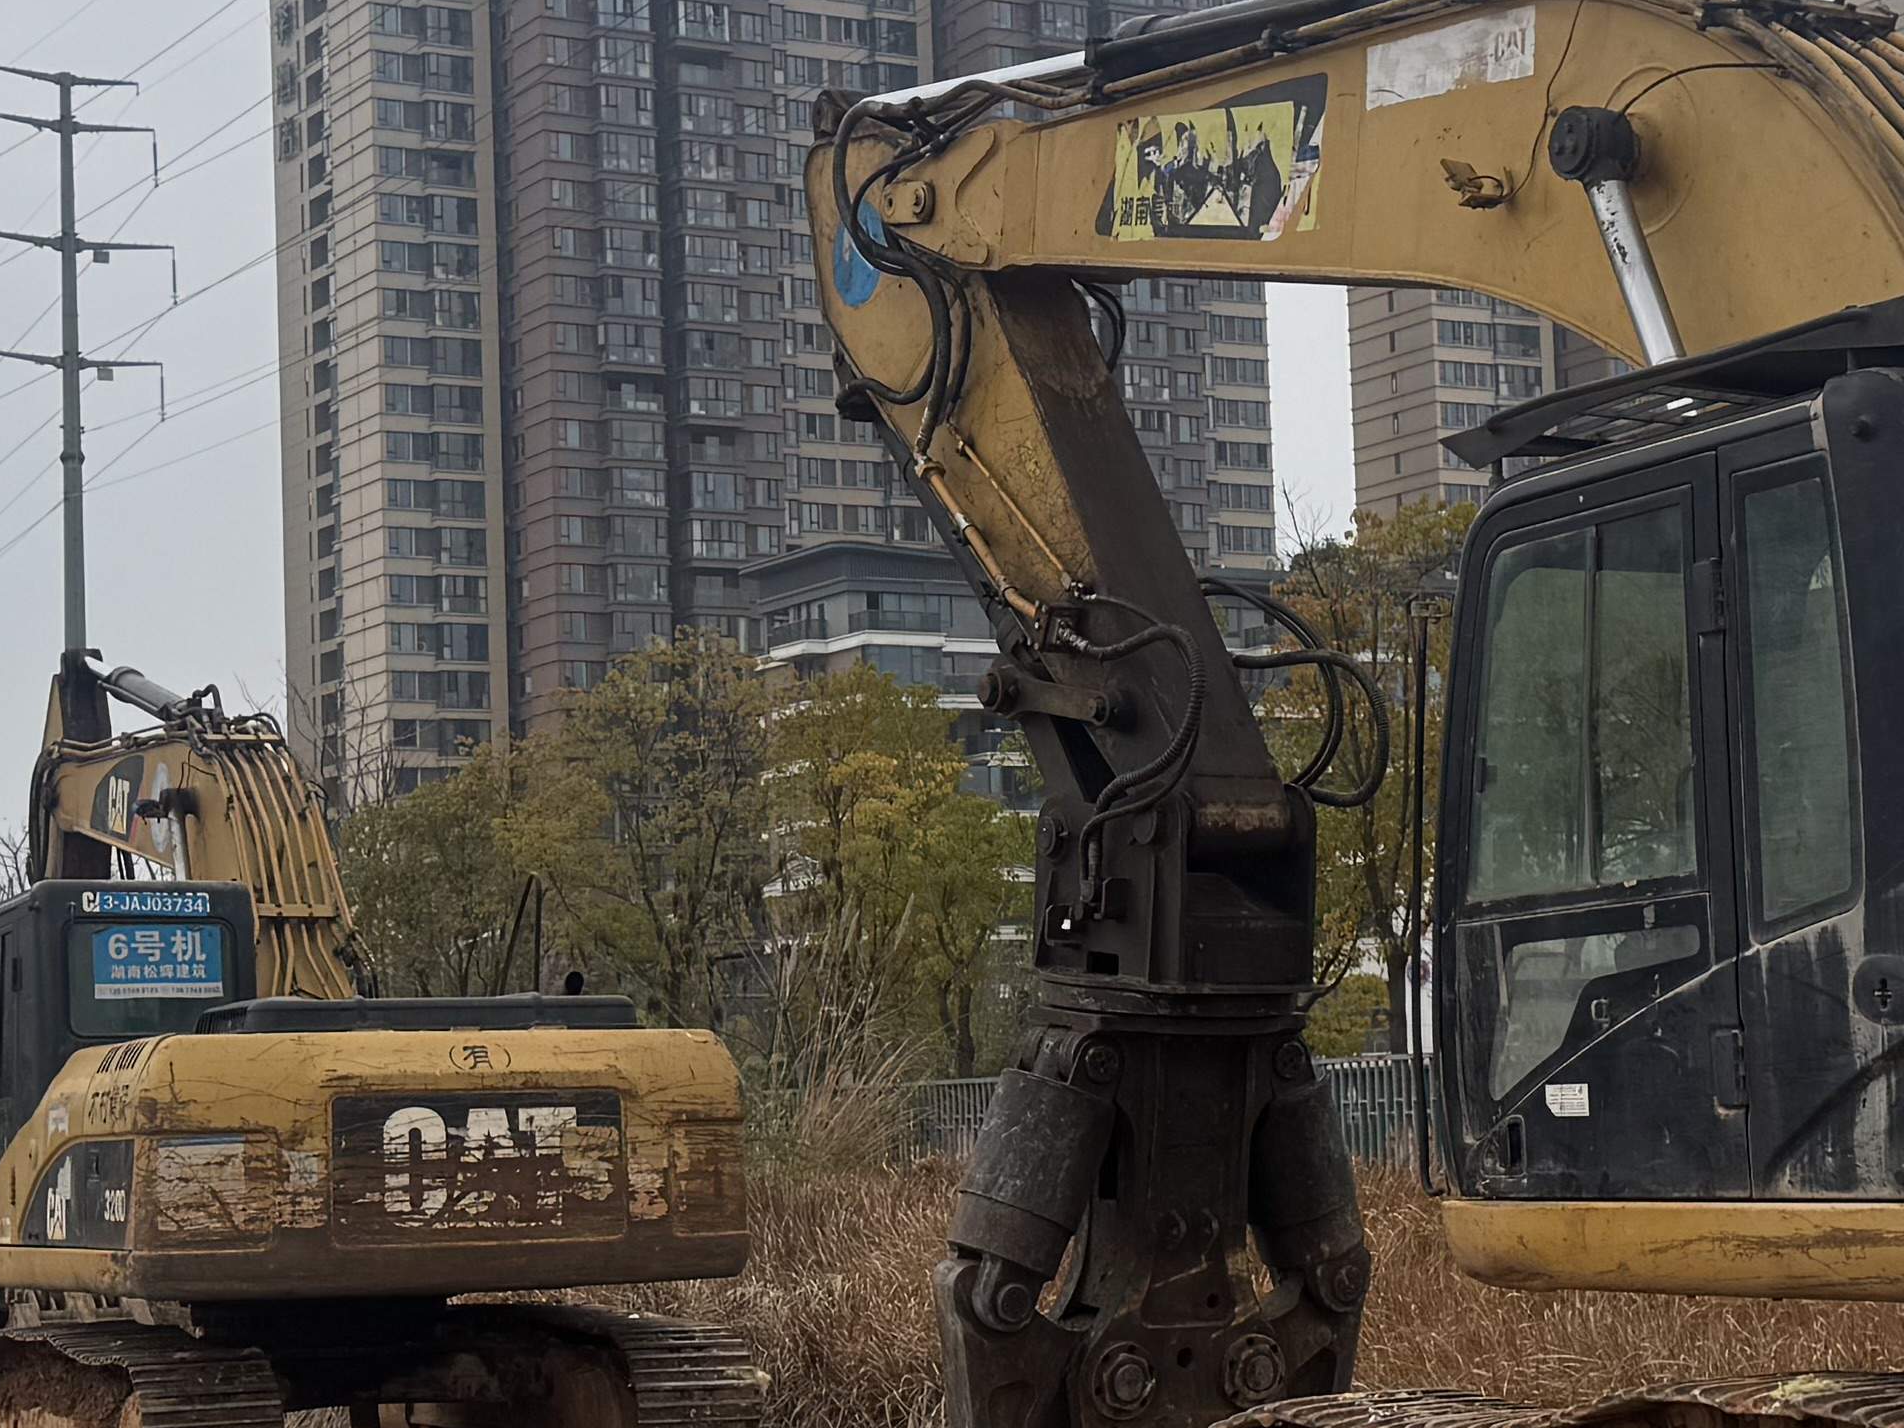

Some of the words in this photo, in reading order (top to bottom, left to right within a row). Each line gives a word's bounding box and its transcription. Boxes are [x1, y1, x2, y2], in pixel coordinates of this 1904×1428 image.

[1495, 28, 1527, 62] CAT
[108, 775, 130, 835] CAT
[103, 895, 204, 913] 3-JAJ03734
[108, 930, 207, 962] 6号机
